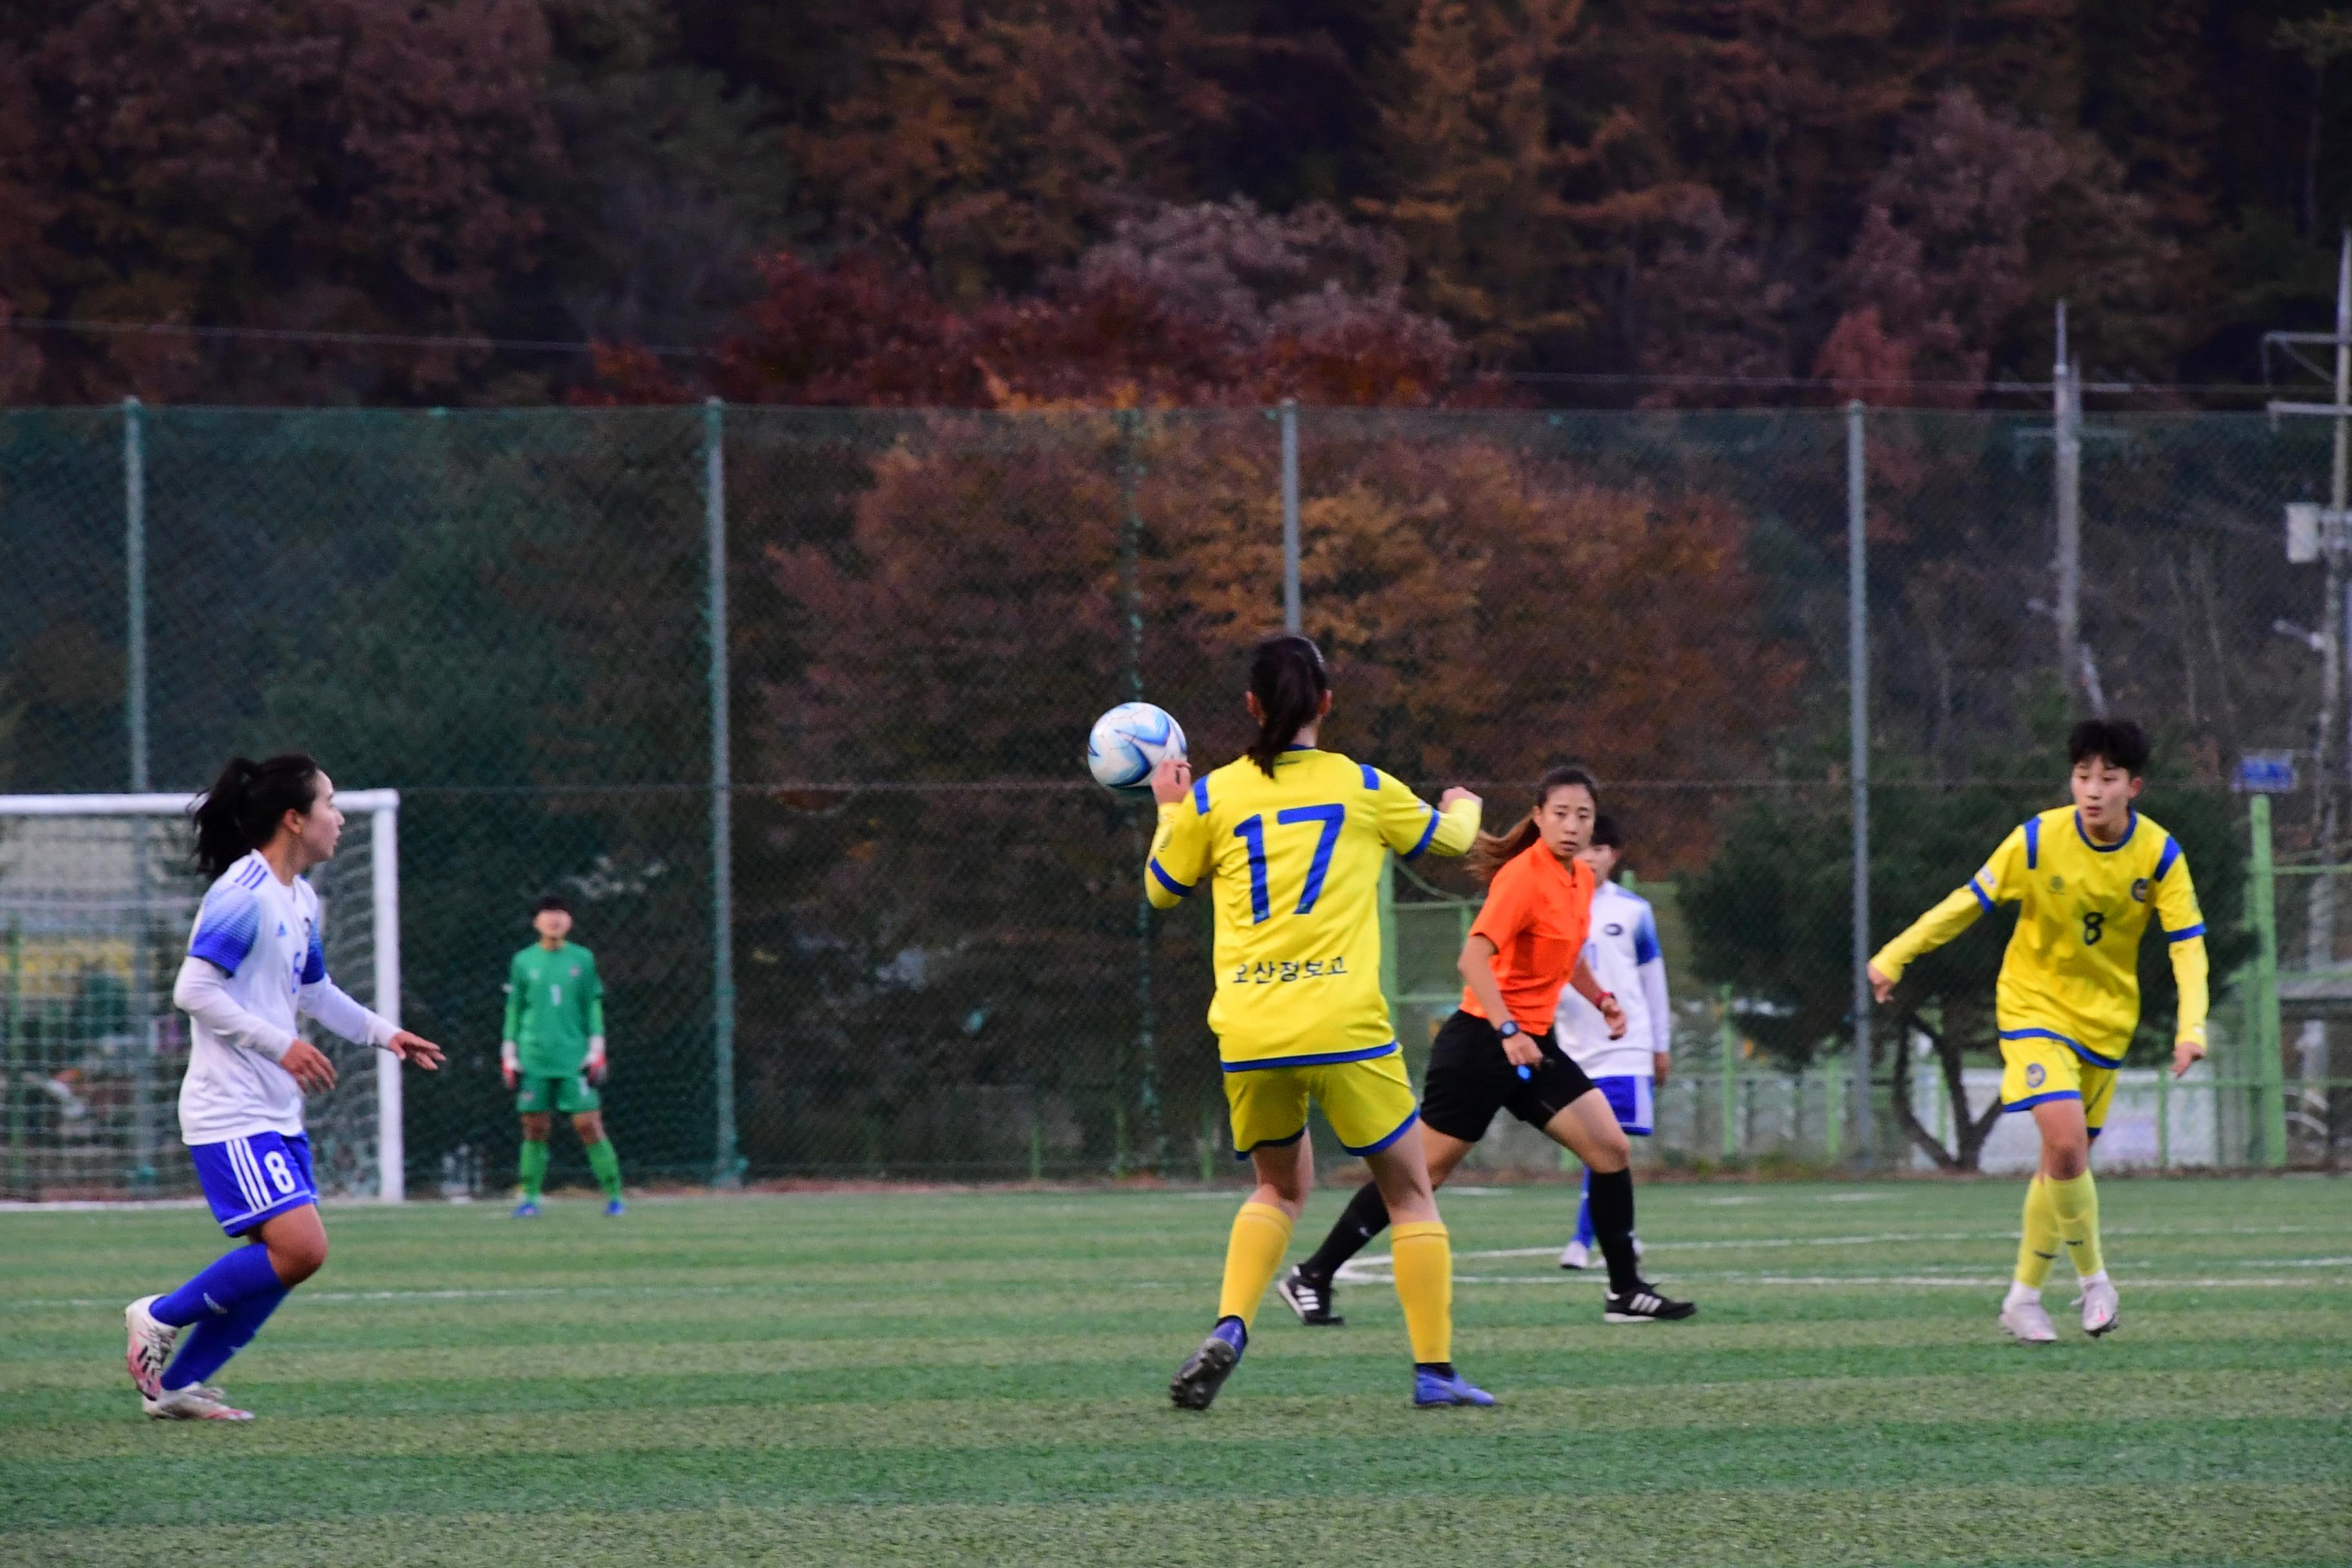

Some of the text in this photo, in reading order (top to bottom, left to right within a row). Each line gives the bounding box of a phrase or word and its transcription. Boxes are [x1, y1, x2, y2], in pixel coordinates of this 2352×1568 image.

[1233, 803, 1345, 925] 17
[2083, 912, 2104, 946] 8
[1233, 956, 1348, 984] 오산정보고
[264, 1150, 296, 1194] 8
